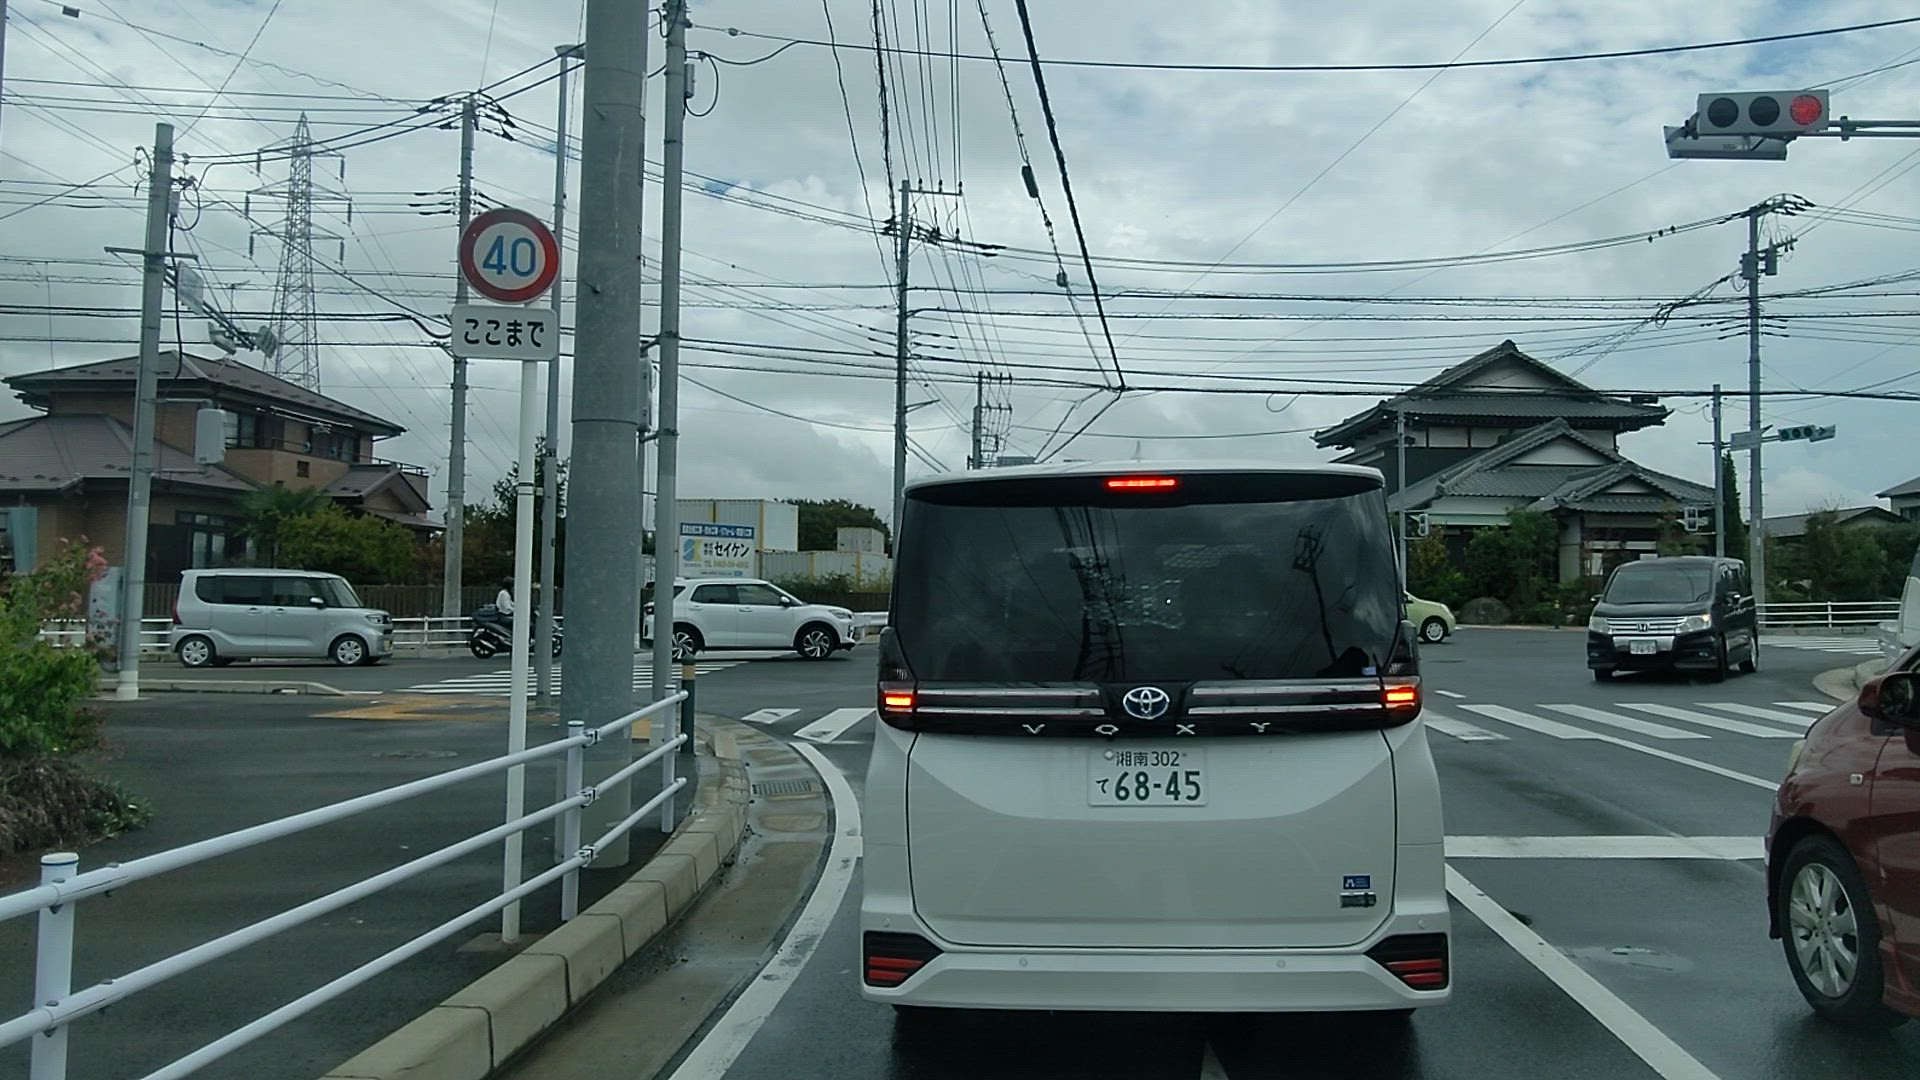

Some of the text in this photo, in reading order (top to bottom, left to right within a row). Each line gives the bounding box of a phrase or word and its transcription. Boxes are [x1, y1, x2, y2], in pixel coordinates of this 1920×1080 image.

[482, 235, 536, 277] 40
[464, 318, 544, 348] ここまで
[714, 541, 749, 558] セイケン
[1114, 771, 1200, 801] 68-45
